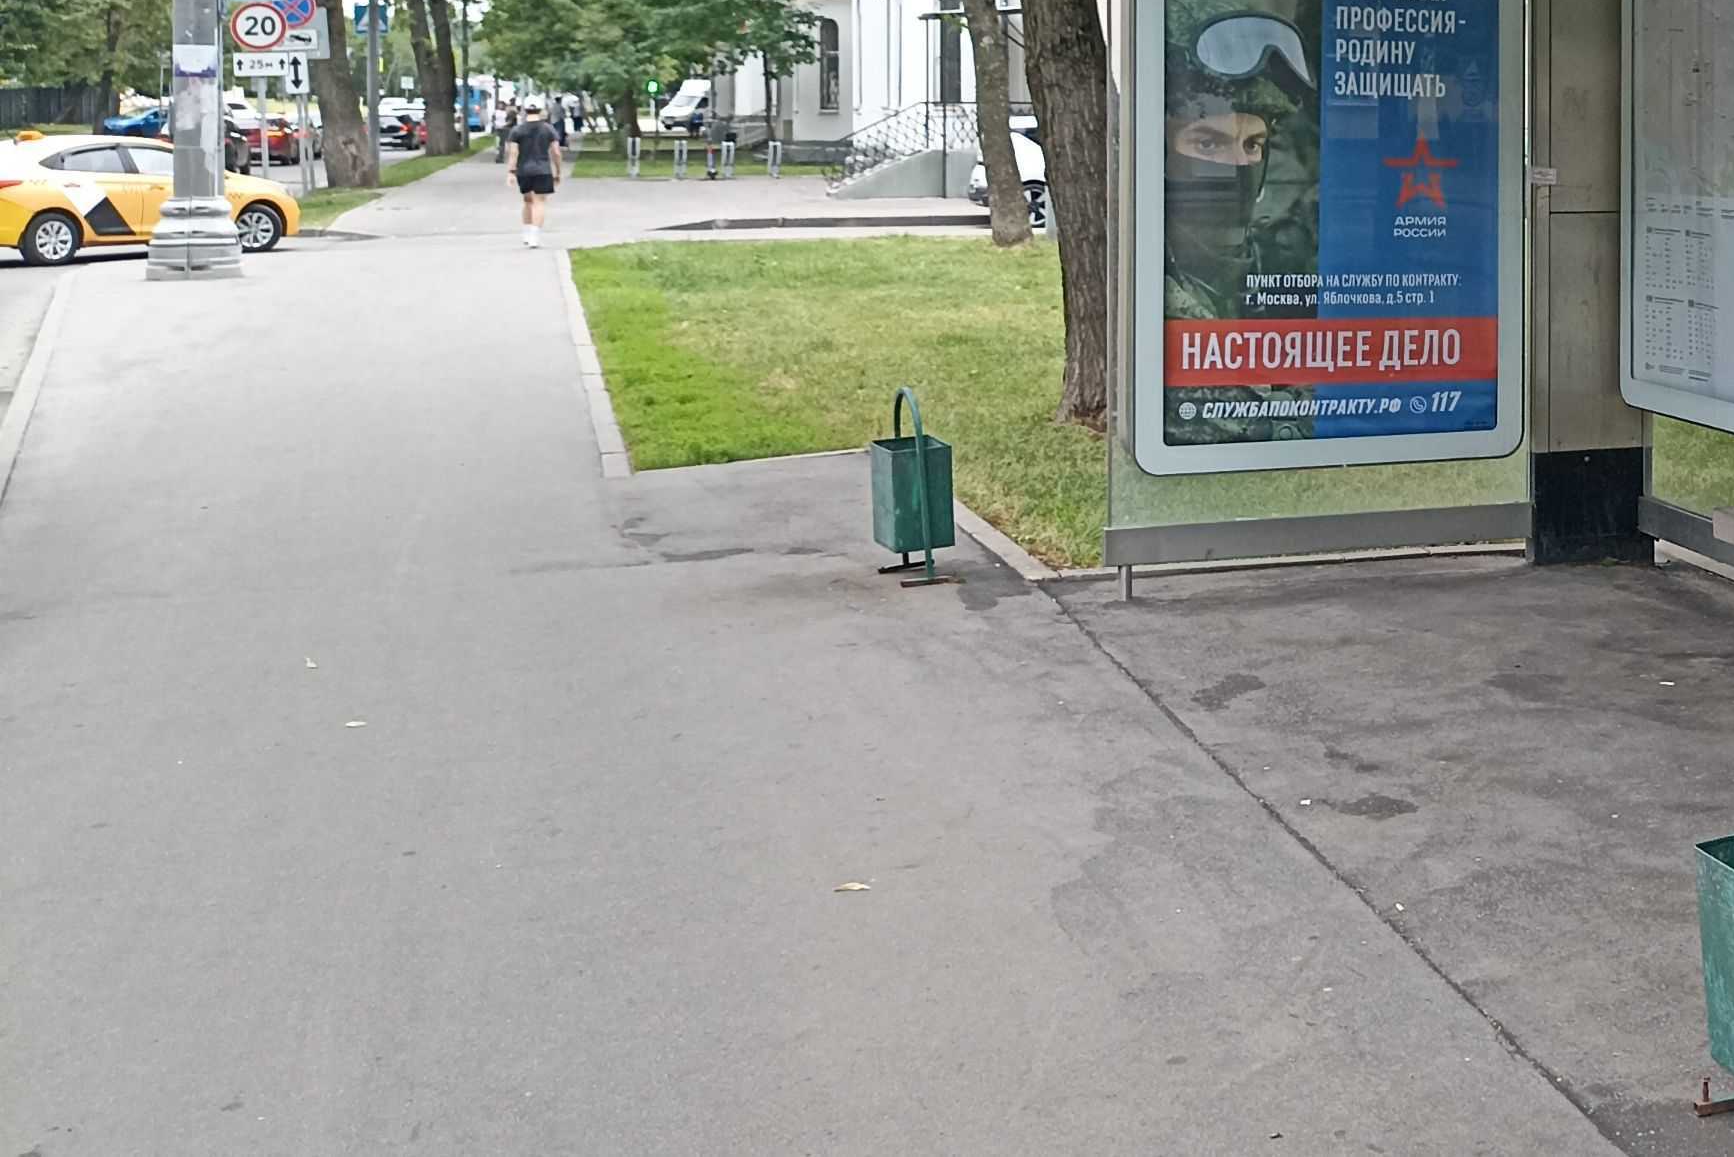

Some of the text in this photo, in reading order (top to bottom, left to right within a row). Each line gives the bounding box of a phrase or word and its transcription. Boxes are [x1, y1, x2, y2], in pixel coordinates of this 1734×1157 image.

[244, 16, 276, 36] 20
[1335, 38, 1416, 67] РОДИНУ
[1334, 71, 1447, 100] ЗАЩИЩАТЬ
[1394, 216, 1447, 226] АРМИЯ
[1393, 228, 1447, 238] РОССИИ
[1246, 273, 1462, 288] ПУНКТ ОТБОРА НА СЛУЖБУ ПО КОНТРАКТУ:
[1246, 294, 1254, 305] г.
[1257, 292, 1303, 306] Москва,
[1305, 294, 1319, 308] ул.
[1323, 291, 1384, 305] Яблочкова,
[1404, 292, 1426, 307] стр.
[1429, 290, 1435, 303] 1
[1181, 328, 1462, 372] НАСТОЯЩЕЕ ДЕЛО
[1202, 391, 1462, 419] СЛУЖБАПОКОНТРАКТУ.РФ 117
